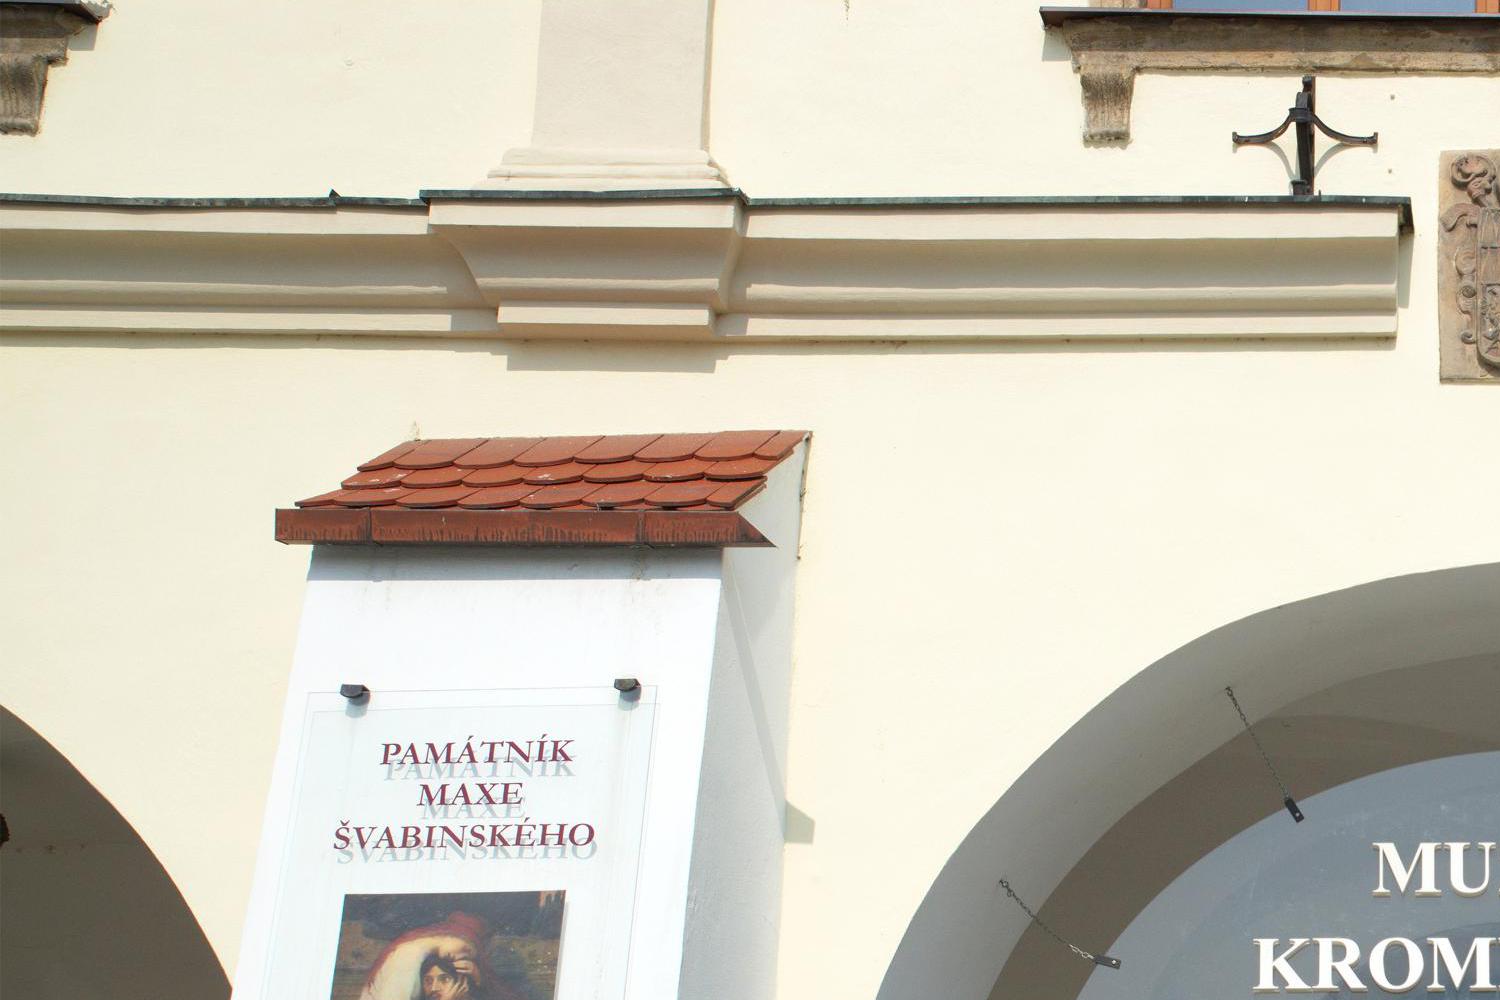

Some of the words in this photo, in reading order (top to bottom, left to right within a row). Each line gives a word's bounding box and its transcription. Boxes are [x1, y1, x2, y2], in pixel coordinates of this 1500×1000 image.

[380, 734, 575, 766] PAMÁTNÍK
[416, 782, 523, 806] MAXE
[333, 817, 596, 850] ŠVABINSKÉHO
